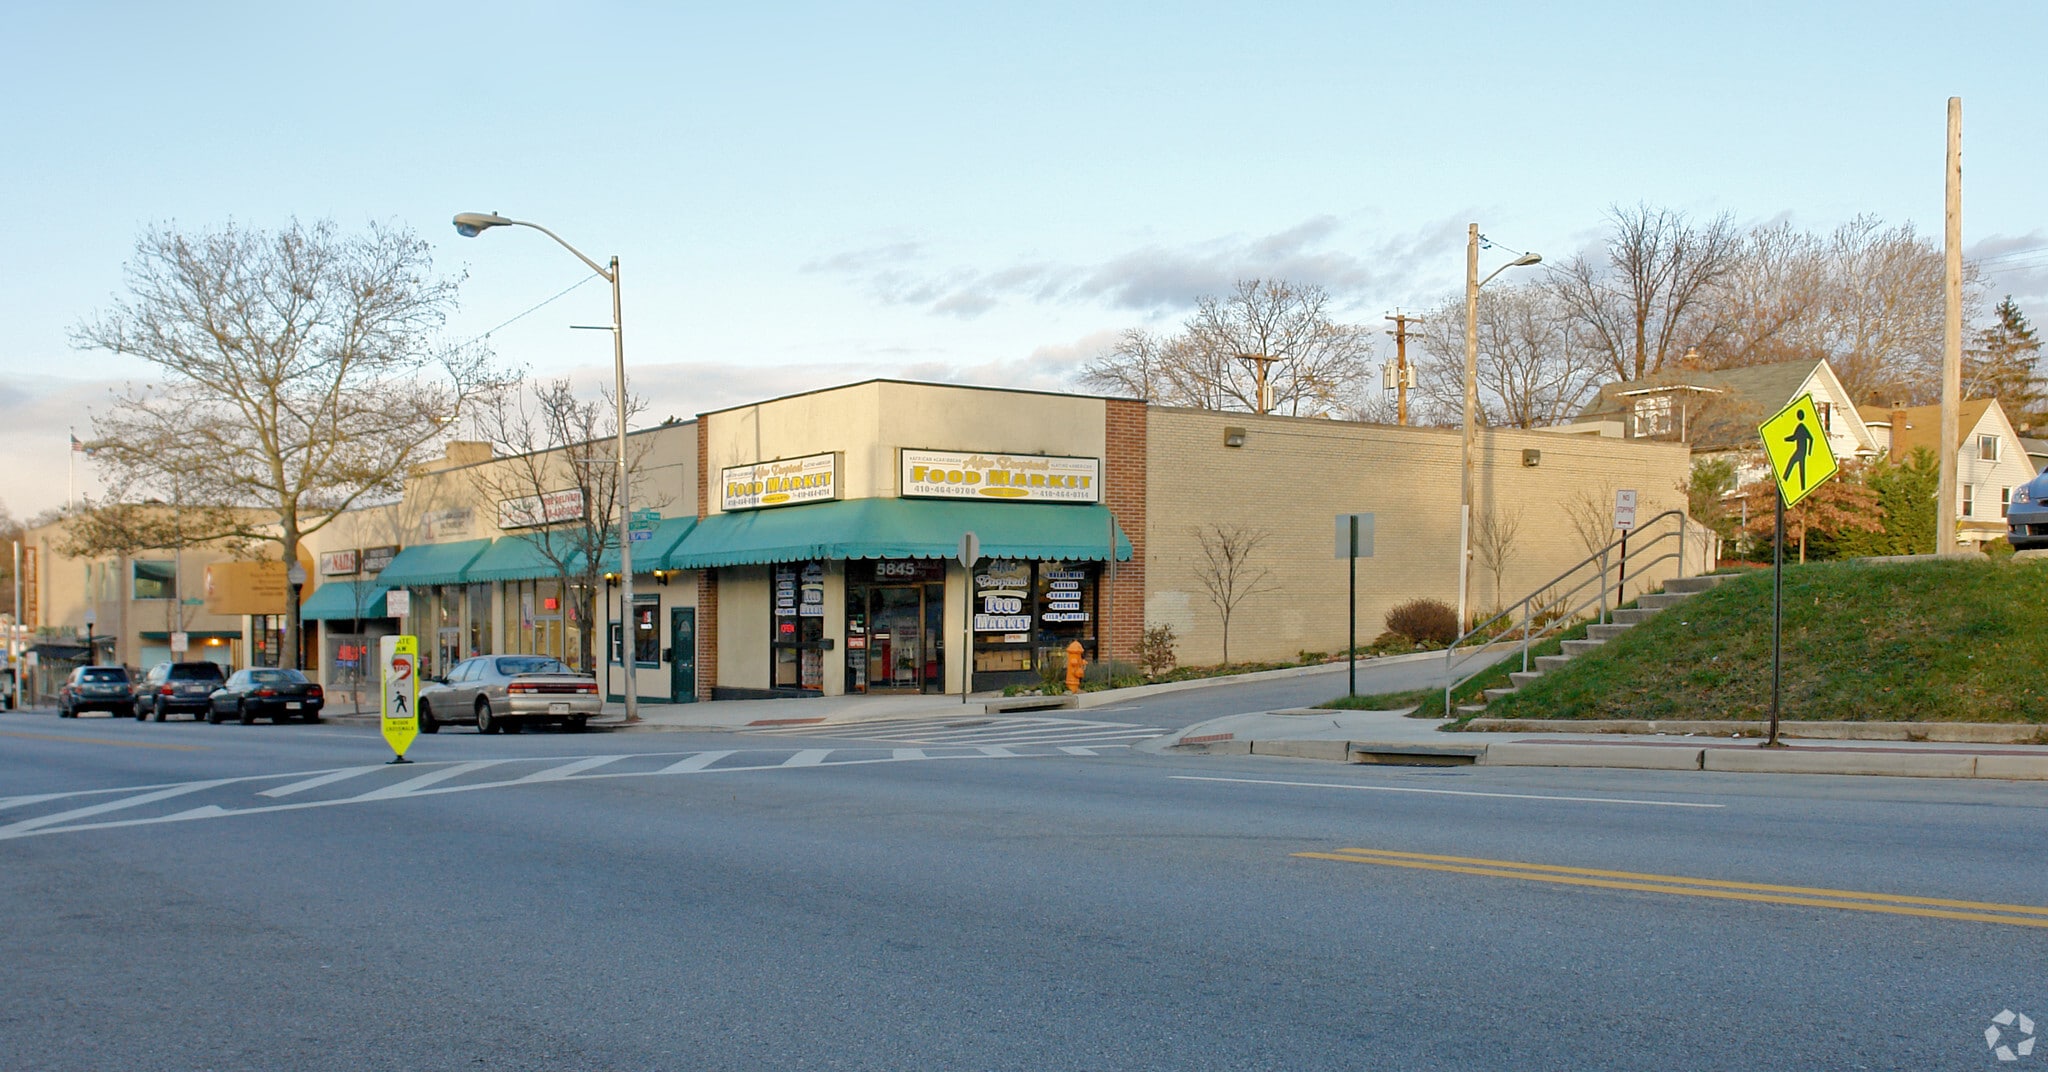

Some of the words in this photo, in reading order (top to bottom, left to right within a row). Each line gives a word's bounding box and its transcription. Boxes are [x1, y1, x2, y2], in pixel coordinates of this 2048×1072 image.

[727, 482, 763, 498] FOOD
[766, 472, 832, 494] MARKET
[910, 466, 982, 485] FOOD
[985, 469, 1093, 489] MARKET
[876, 563, 915, 575] 5845
[985, 596, 1021, 613] FOOD
[975, 614, 1031, 631] MARKET
